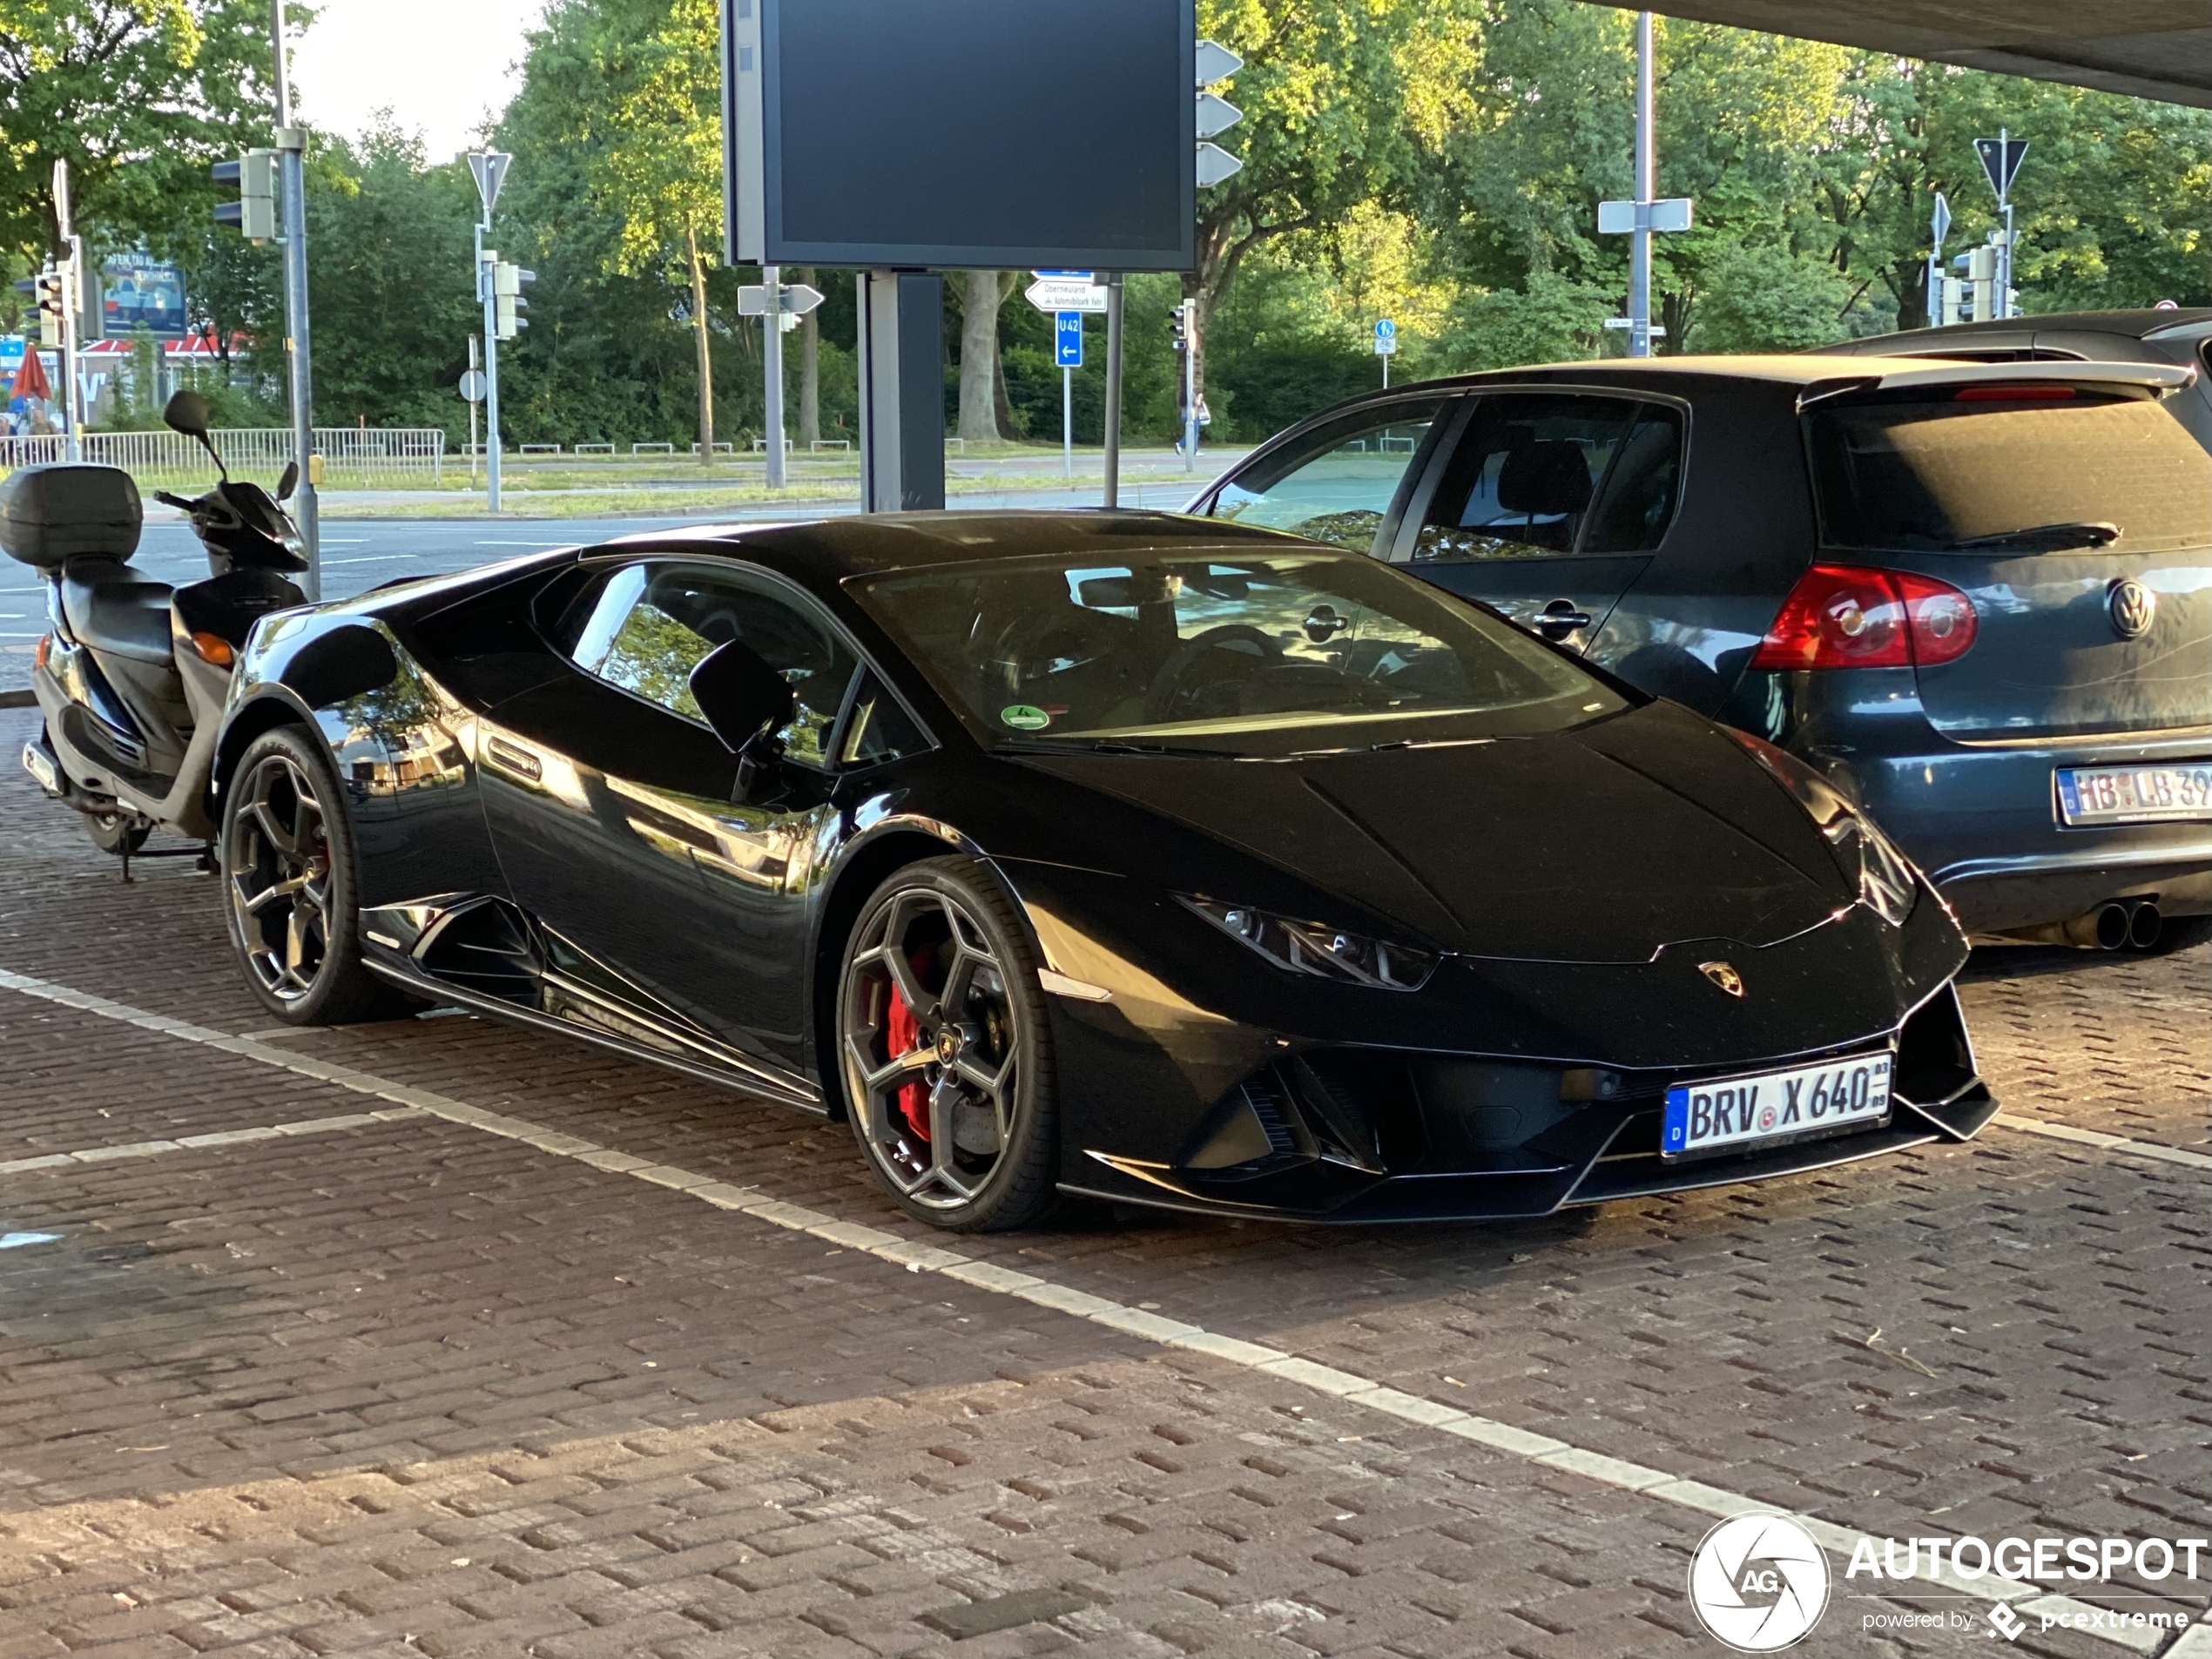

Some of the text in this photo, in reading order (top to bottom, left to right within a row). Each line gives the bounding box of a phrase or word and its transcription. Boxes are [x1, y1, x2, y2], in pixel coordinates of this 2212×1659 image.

[1044, 284, 1086, 293] Oberneuland
[2076, 770, 2212, 811] HB LB 39
[2066, 799, 2075, 810] D
[1875, 1062, 1888, 1076] 03
[1692, 1065, 1870, 1139] BRV X 640
[1871, 1094, 1885, 1108] 09
[1672, 1126, 1681, 1141] D
